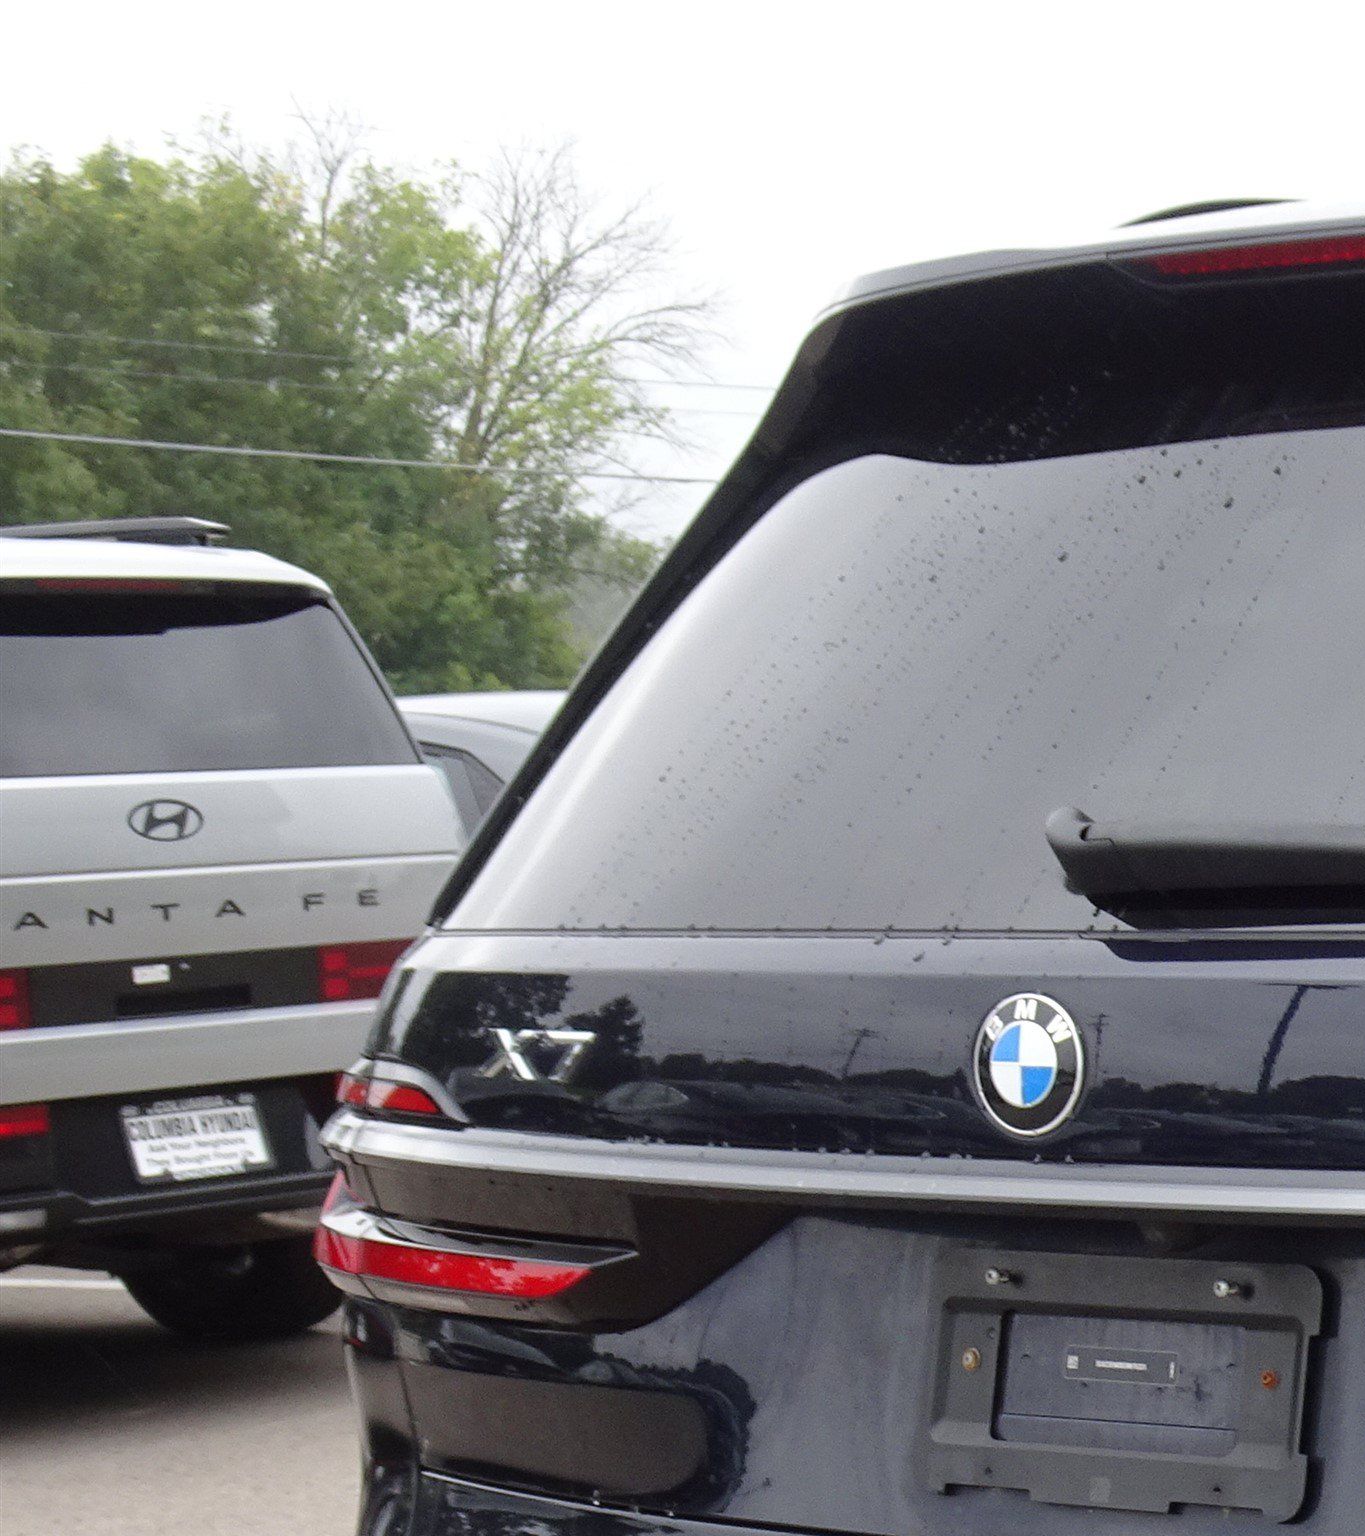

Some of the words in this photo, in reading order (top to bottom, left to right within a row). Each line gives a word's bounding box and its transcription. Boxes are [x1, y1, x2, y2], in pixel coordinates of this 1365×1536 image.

[302, 888, 381, 911] FE
[985, 998, 1073, 1042] BMW
[472, 1027, 597, 1082] X7
[199, 1111, 256, 1134] HYUNDAI
